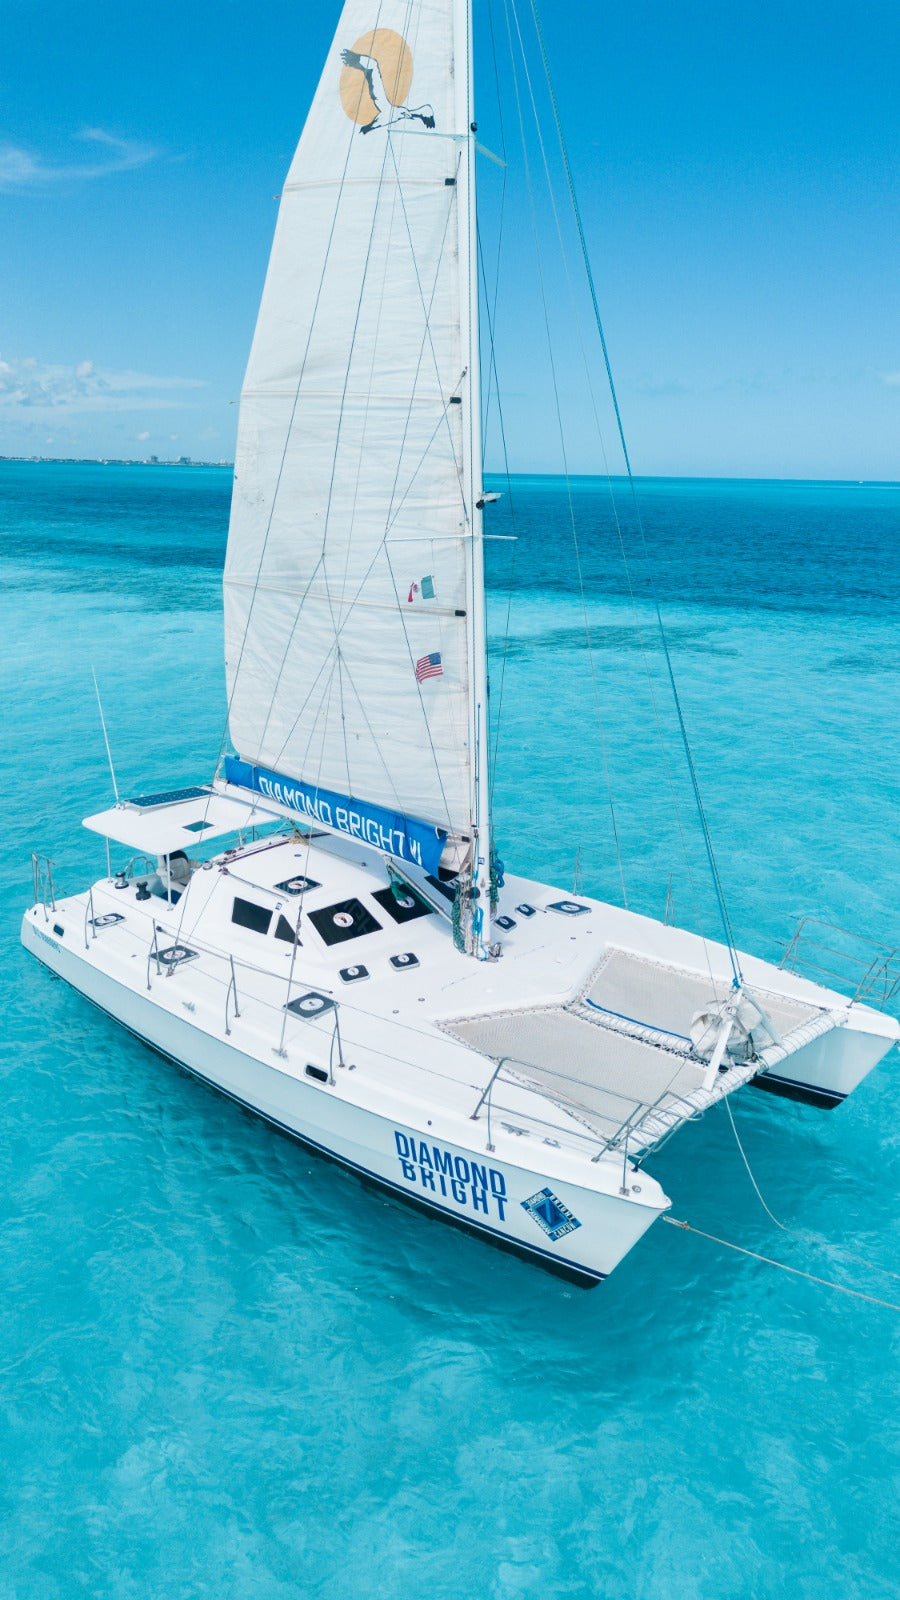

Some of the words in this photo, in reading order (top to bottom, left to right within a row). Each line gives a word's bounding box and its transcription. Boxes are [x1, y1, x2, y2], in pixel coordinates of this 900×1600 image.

[258, 775, 333, 826] DIAMOND
[335, 806, 406, 858] BRIGHT
[394, 1130, 507, 1197] DIAMOND
[398, 1157, 509, 1222] BRIGHT
